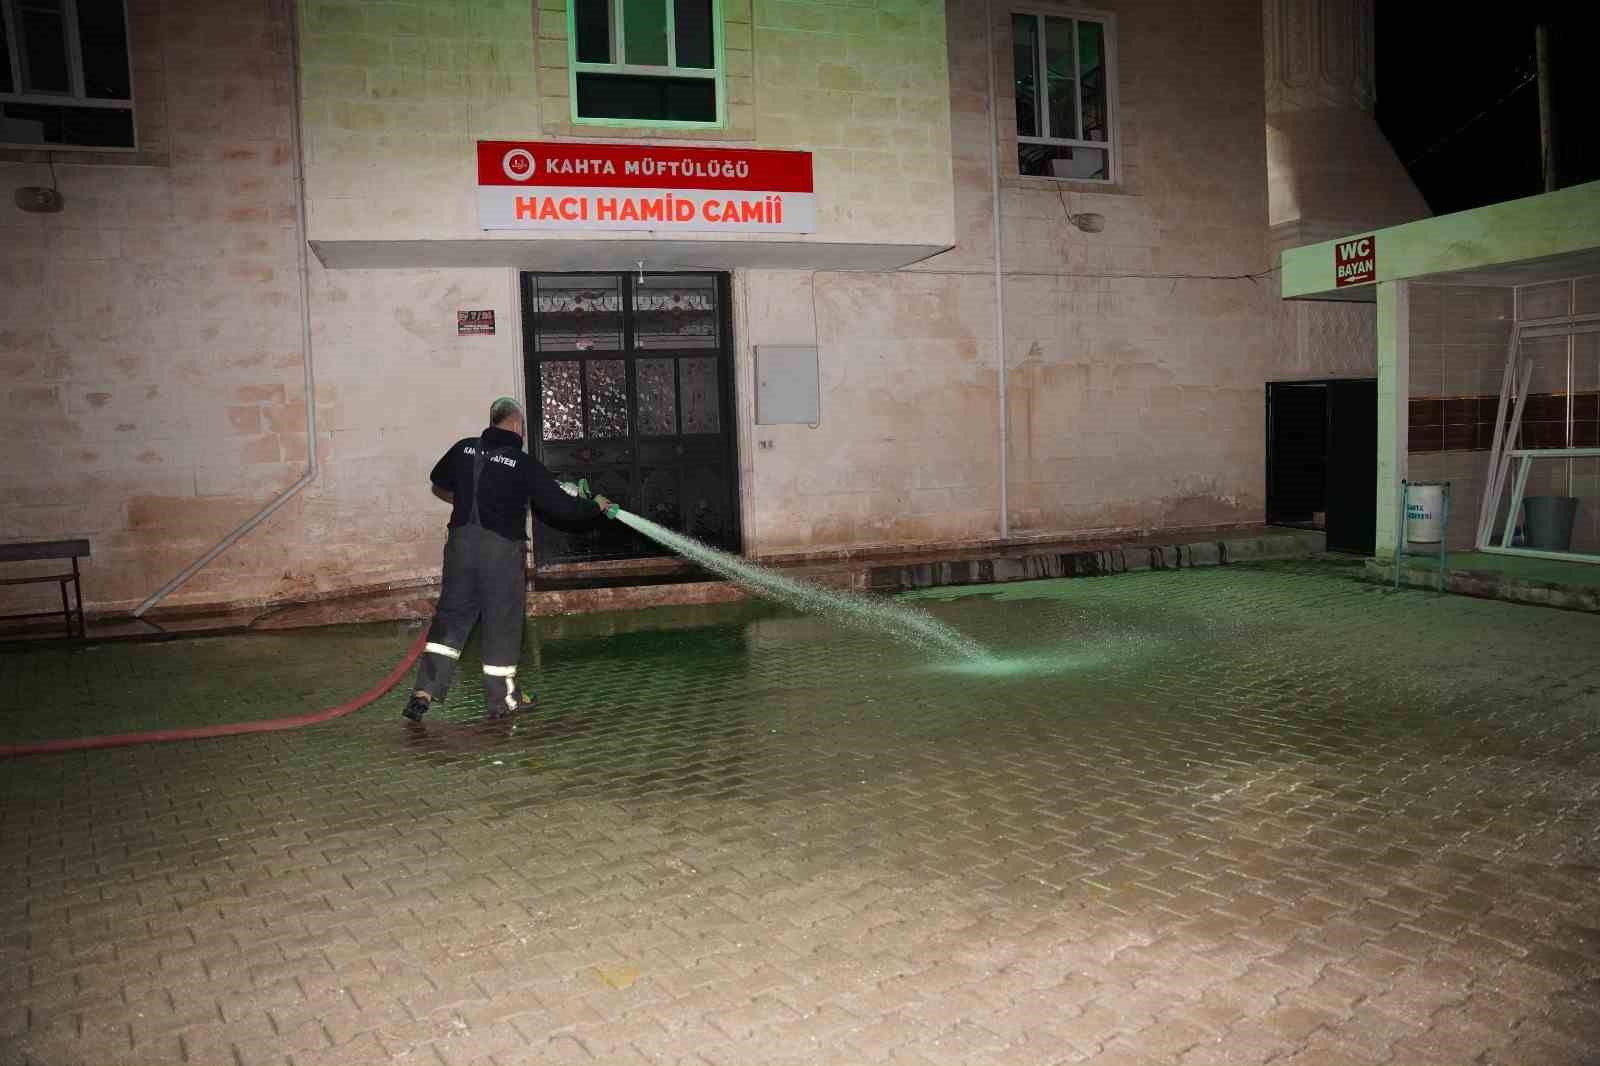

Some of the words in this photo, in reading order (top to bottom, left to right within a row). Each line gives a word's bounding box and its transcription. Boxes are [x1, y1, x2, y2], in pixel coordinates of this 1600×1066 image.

[546, 158, 616, 174] KAHTA
[624, 157, 749, 178] MÜFTÜLÜĞÜ
[515, 196, 588, 220] HACI
[597, 193, 695, 222] HAMİD
[1340, 239, 1370, 261] WC
[1338, 259, 1373, 277] BAYAN
